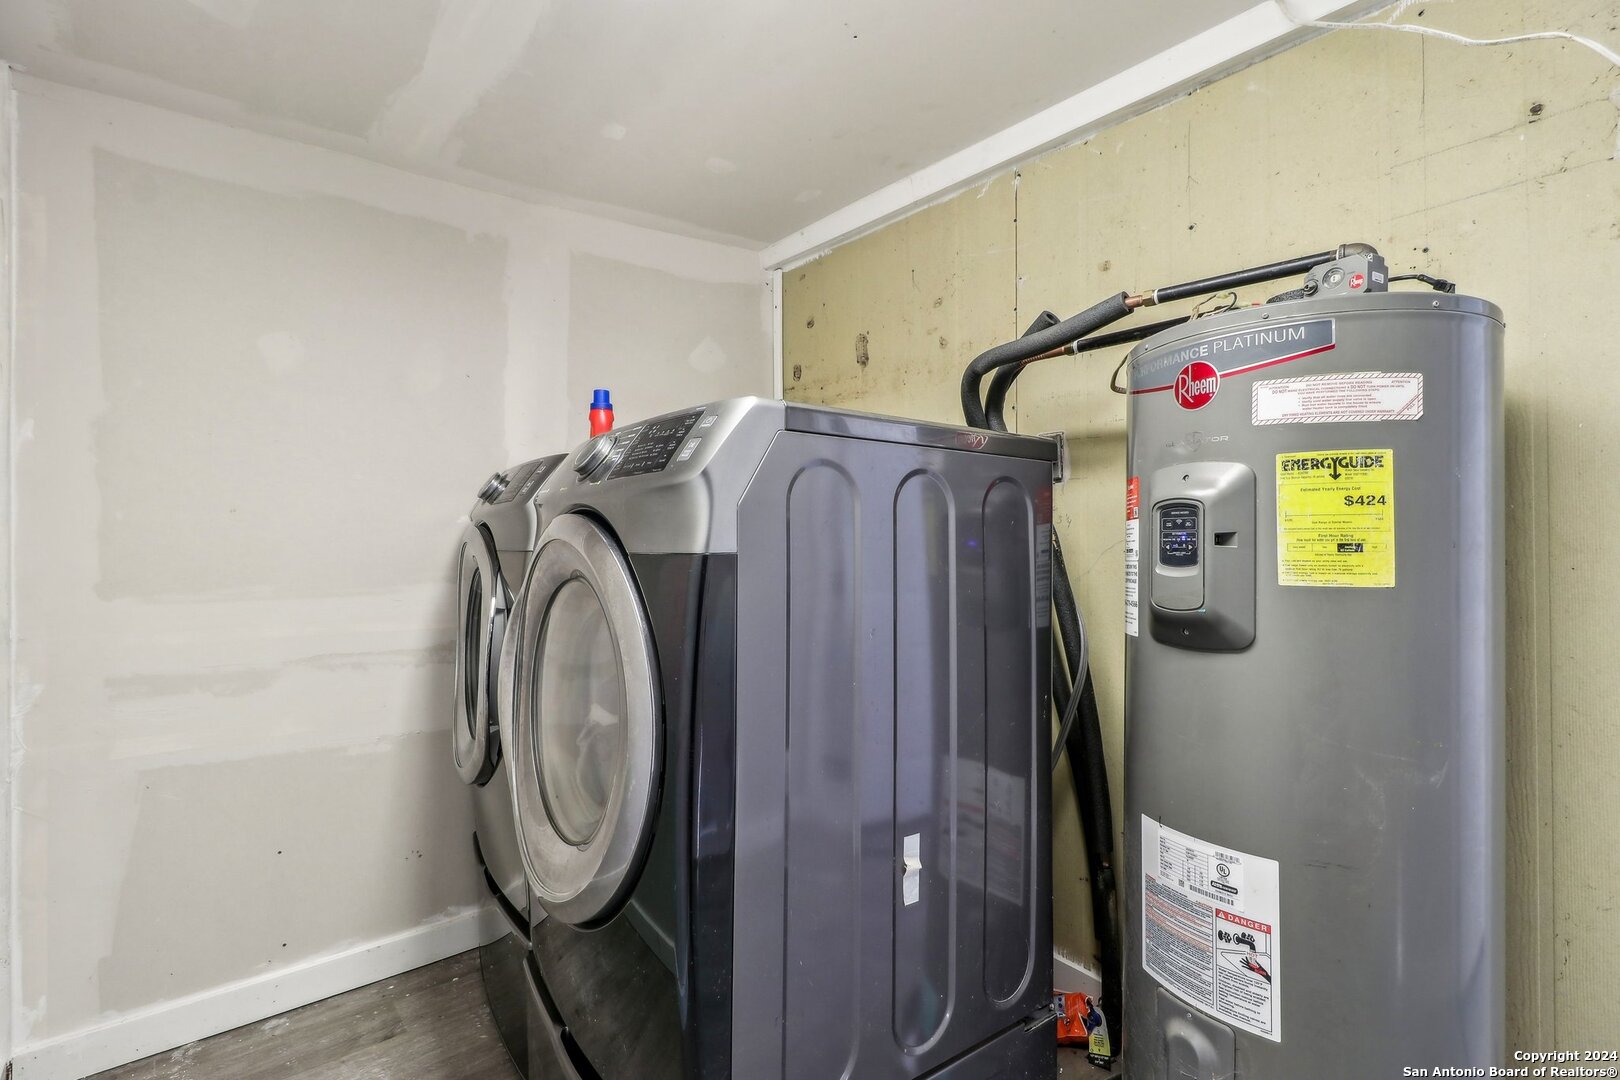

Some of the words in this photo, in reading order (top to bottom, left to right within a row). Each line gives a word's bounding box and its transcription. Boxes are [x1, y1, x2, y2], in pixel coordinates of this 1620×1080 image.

[1213, 326, 1305, 354] PLATINUM
[1178, 365, 1216, 404] Rheem
[1344, 495, 1386, 506] $424
[1219, 864, 1227, 875] UL
[1227, 912, 1268, 932] DANGER
[1246, 951, 1258, 959] HOT
